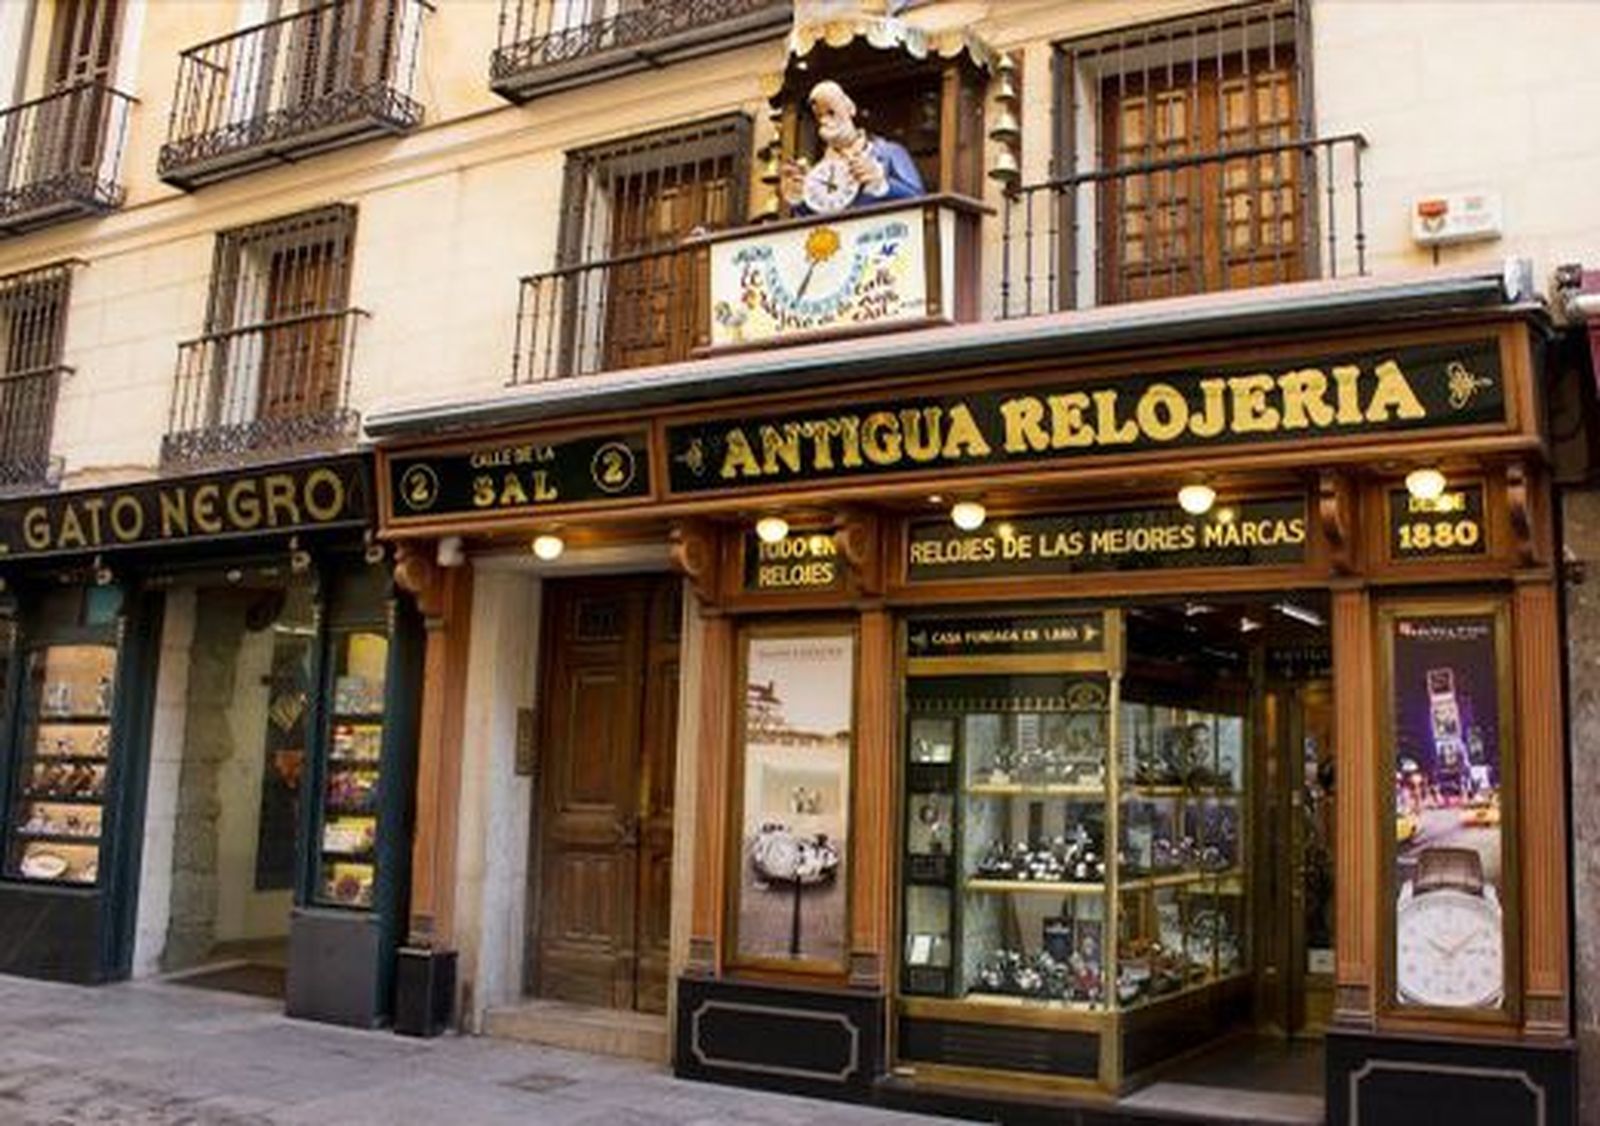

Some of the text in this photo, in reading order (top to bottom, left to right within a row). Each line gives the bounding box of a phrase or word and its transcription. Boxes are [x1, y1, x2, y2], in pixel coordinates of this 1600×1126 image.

[721, 359, 1426, 479] ANTIGUA RELOJERIA
[470, 444, 555, 469] CALLE DE LA
[603, 450, 625, 483] 2
[410, 472, 429, 502] 2
[473, 470, 558, 507] SAL
[23, 468, 345, 549] GATO NEGRO
[910, 518, 1306, 564] RELOJES DE LAS MEJORES MARCAS
[1398, 520, 1479, 549] 1880
[759, 562, 835, 587] RELOJES
[931, 630, 962, 643] CASA
[1022, 628, 1039, 641] EN
